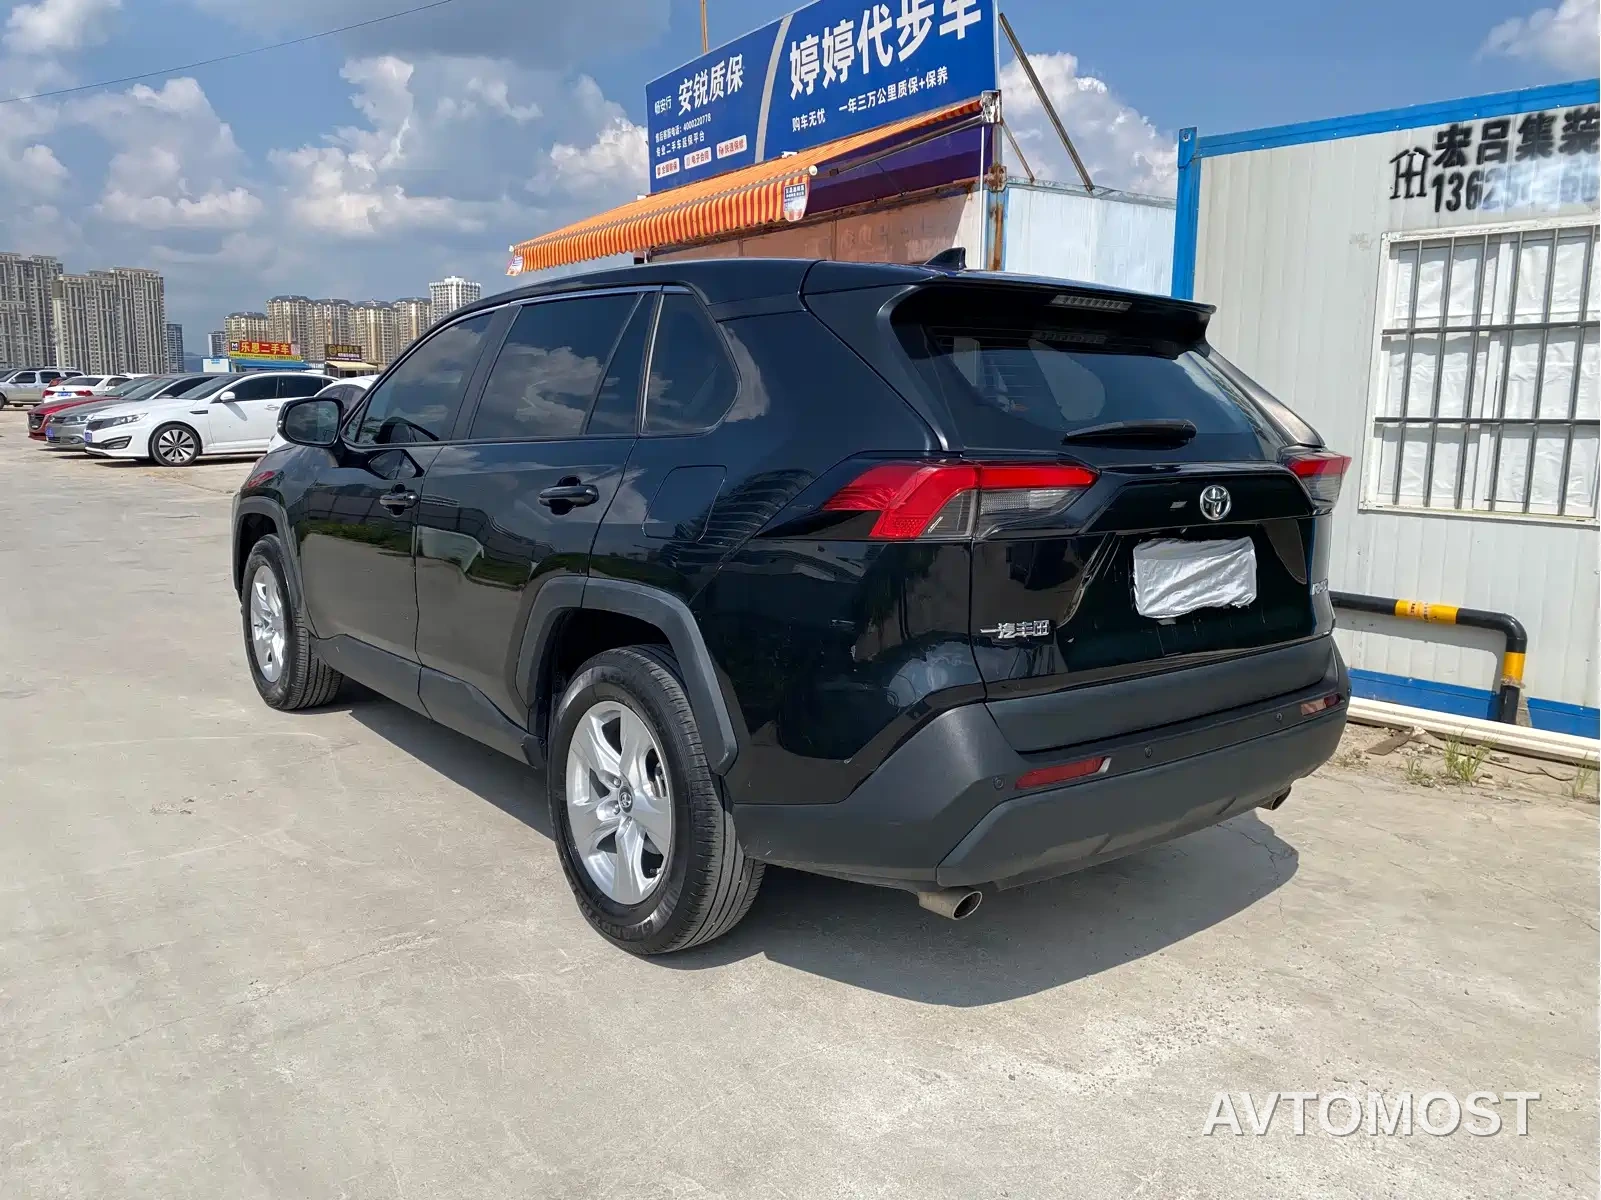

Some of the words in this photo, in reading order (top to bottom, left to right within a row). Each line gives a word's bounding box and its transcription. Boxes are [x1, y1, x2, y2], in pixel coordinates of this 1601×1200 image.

[789, 0, 982, 100] 婷婷代步车
[678, 53, 744, 116] 安锐质保
[792, 107, 826, 133] 购车无忧
[838, 66, 948, 114] 一年三万公里质保+保养
[240, 341, 290, 355] 乐恩二手车
[980, 619, 1050, 639] 一汽丰田
